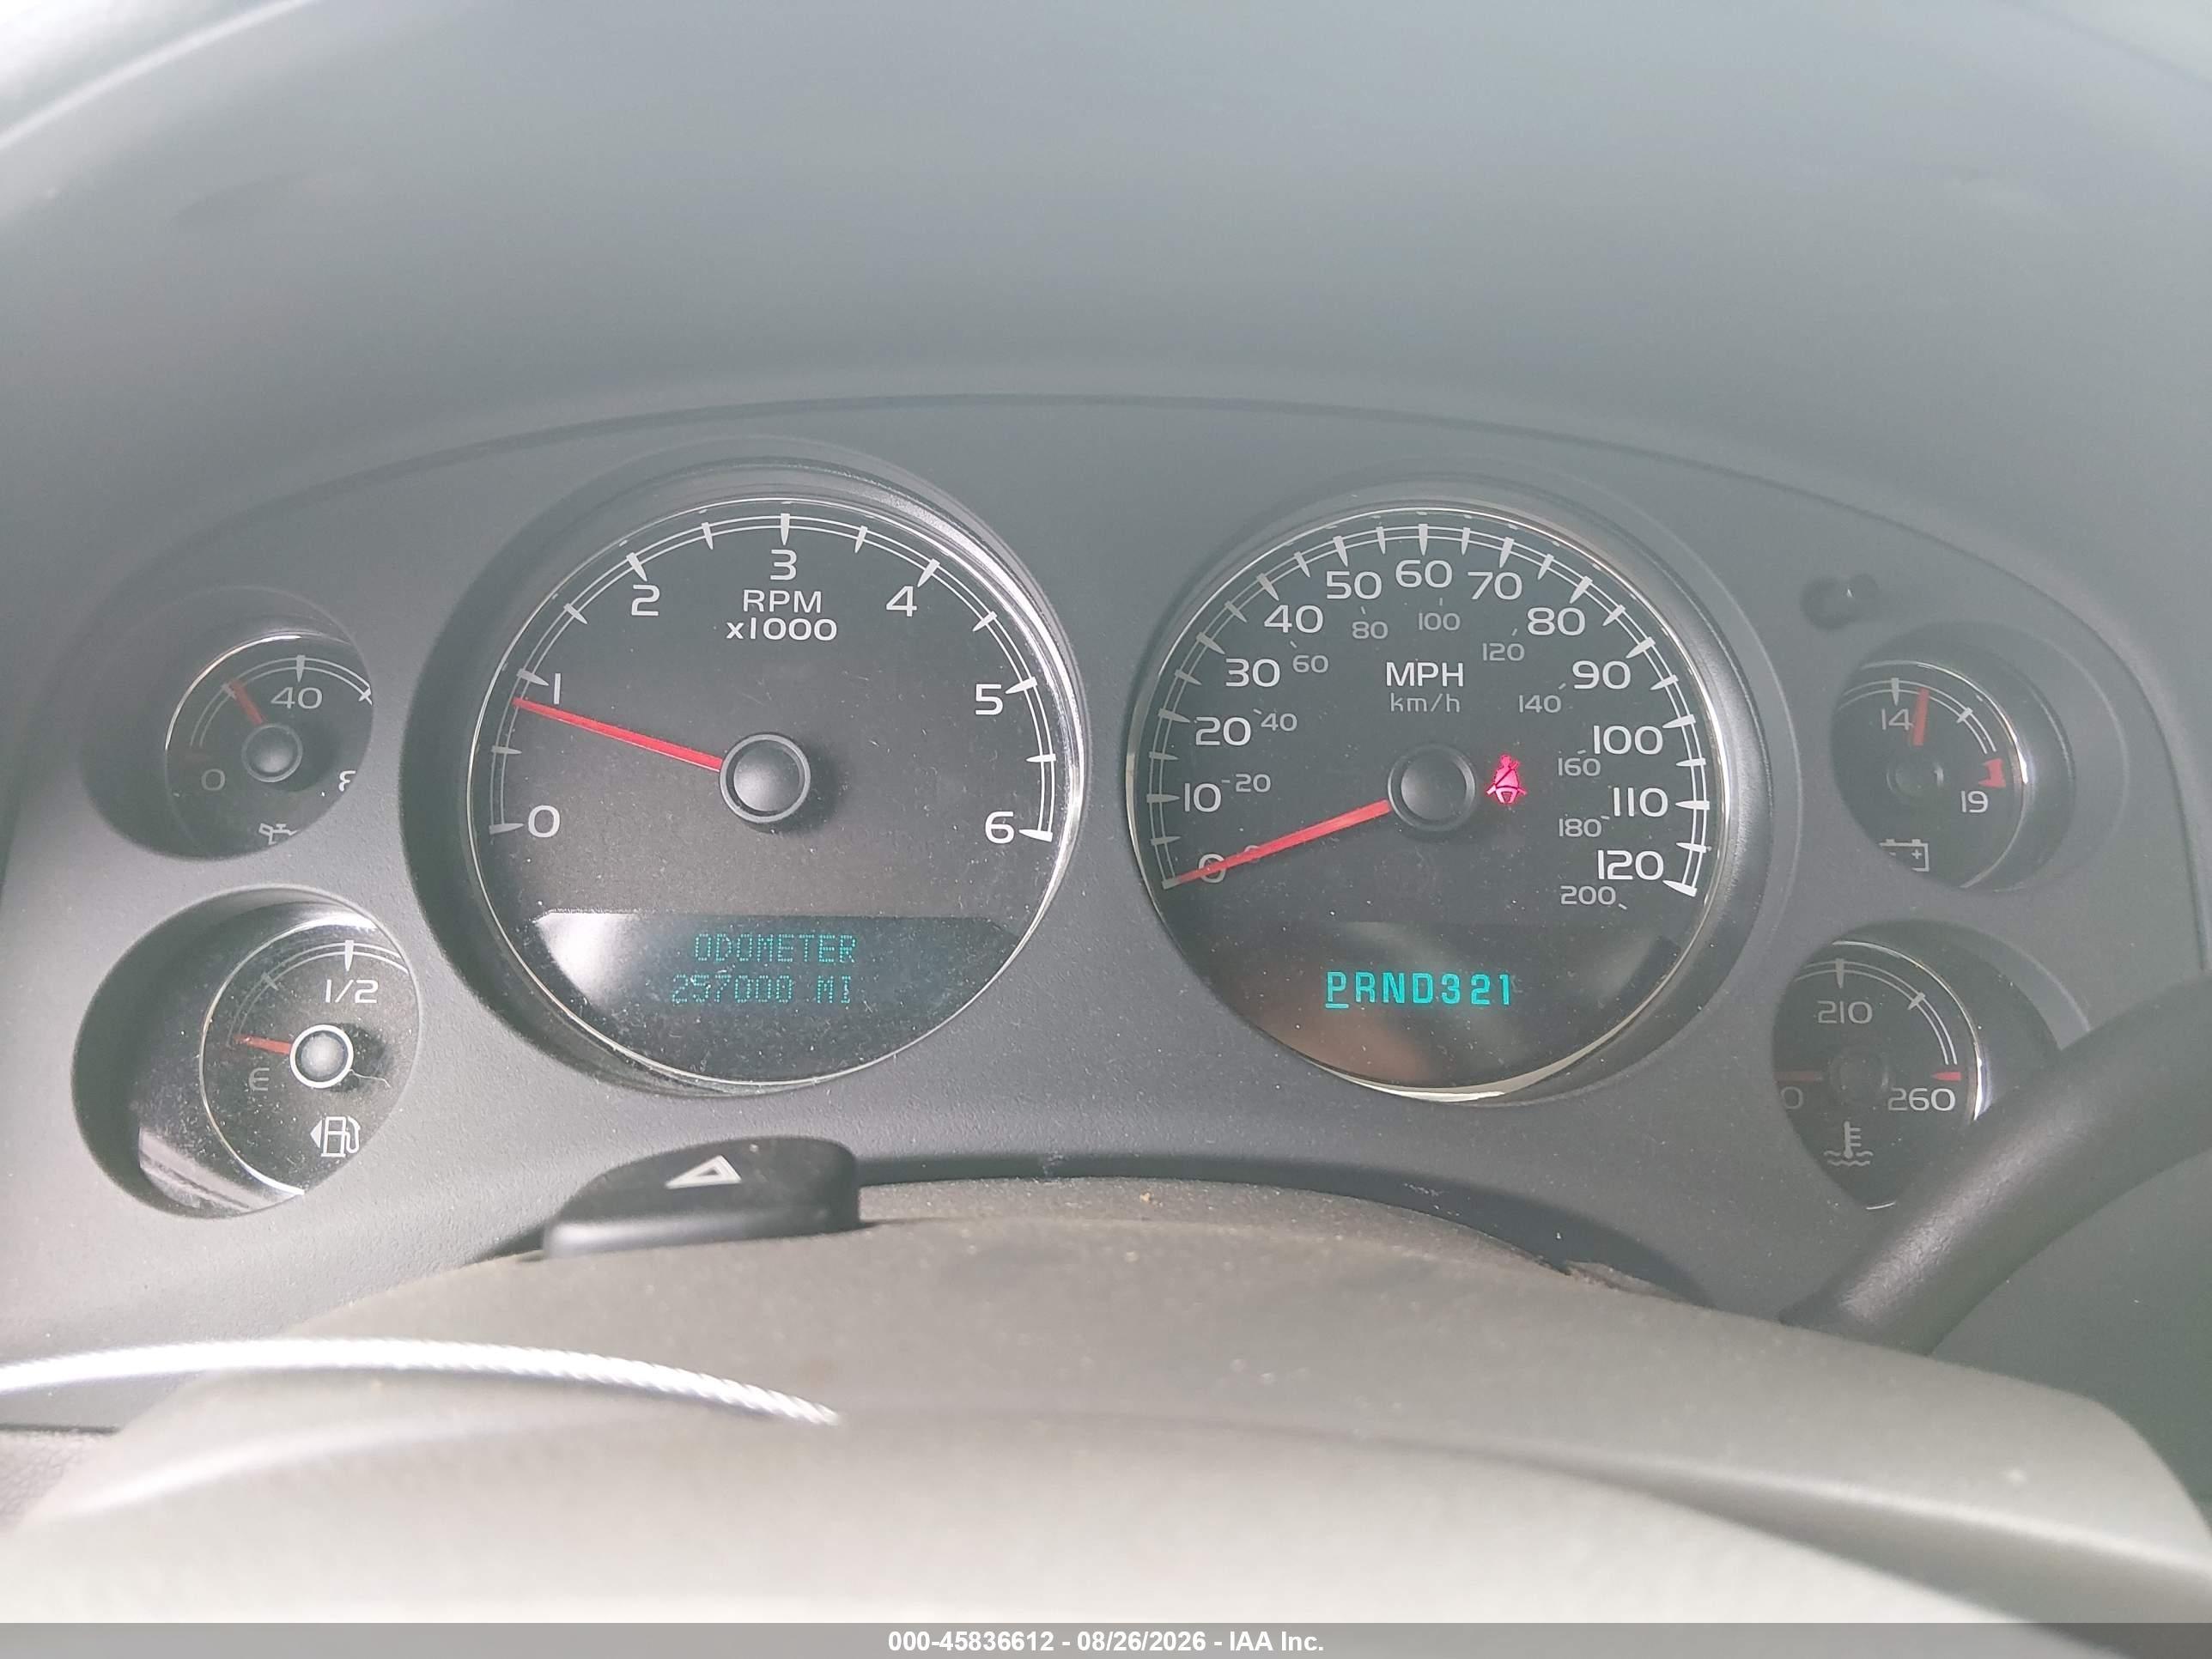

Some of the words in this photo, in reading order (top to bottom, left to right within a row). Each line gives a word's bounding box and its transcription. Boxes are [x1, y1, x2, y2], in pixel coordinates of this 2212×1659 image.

[770, 549, 797, 580] 3
[1395, 559, 1452, 589] 60
[1326, 570, 1382, 600] 50
[1467, 571, 1523, 601] 70
[630, 585, 660, 617] 2
[742, 590, 823, 614] RPM
[885, 586, 917, 617] 4
[725, 617, 838, 641] x1000
[1263, 605, 1324, 634] 40
[1352, 622, 1389, 640] 80
[1418, 612, 1461, 631] 100
[1526, 607, 1586, 636] 80
[1292, 654, 1329, 674] 60
[1482, 642, 1525, 662] 120
[1224, 658, 1281, 688] 30
[1385, 662, 1464, 687] MPH
[1571, 659, 1631, 690] 90
[270, 686, 323, 709] 40
[552, 672, 562, 705] 1
[975, 684, 1003, 716] 5
[1389, 692, 1461, 714] km/h
[1518, 695, 1562, 714] 140
[1195, 716, 1252, 746] 20
[1261, 713, 1298, 732] 40
[1881, 708, 1914, 731] 14
[1593, 725, 1663, 756] 100
[1557, 757, 1601, 777] 160
[201, 769, 226, 791] 0
[1235, 773, 1272, 793] 20
[1183, 782, 1222, 813] 10
[1613, 787, 1668, 817] 110
[1960, 790, 1989, 813] 19
[527, 805, 562, 839] 0
[984, 811, 1015, 844] 6
[1559, 818, 1602, 838] 180
[1597, 849, 1664, 881] 120
[1560, 886, 1616, 905] 200
[696, 933, 857, 963] ODOMETER
[325, 979, 379, 1004] 1/2
[672, 974, 792, 1004] 257000
[817, 975, 851, 1004] MI
[1817, 1000, 1873, 1024] 210
[249, 1067, 270, 1091] E
[1888, 1088, 1956, 1111] 260
